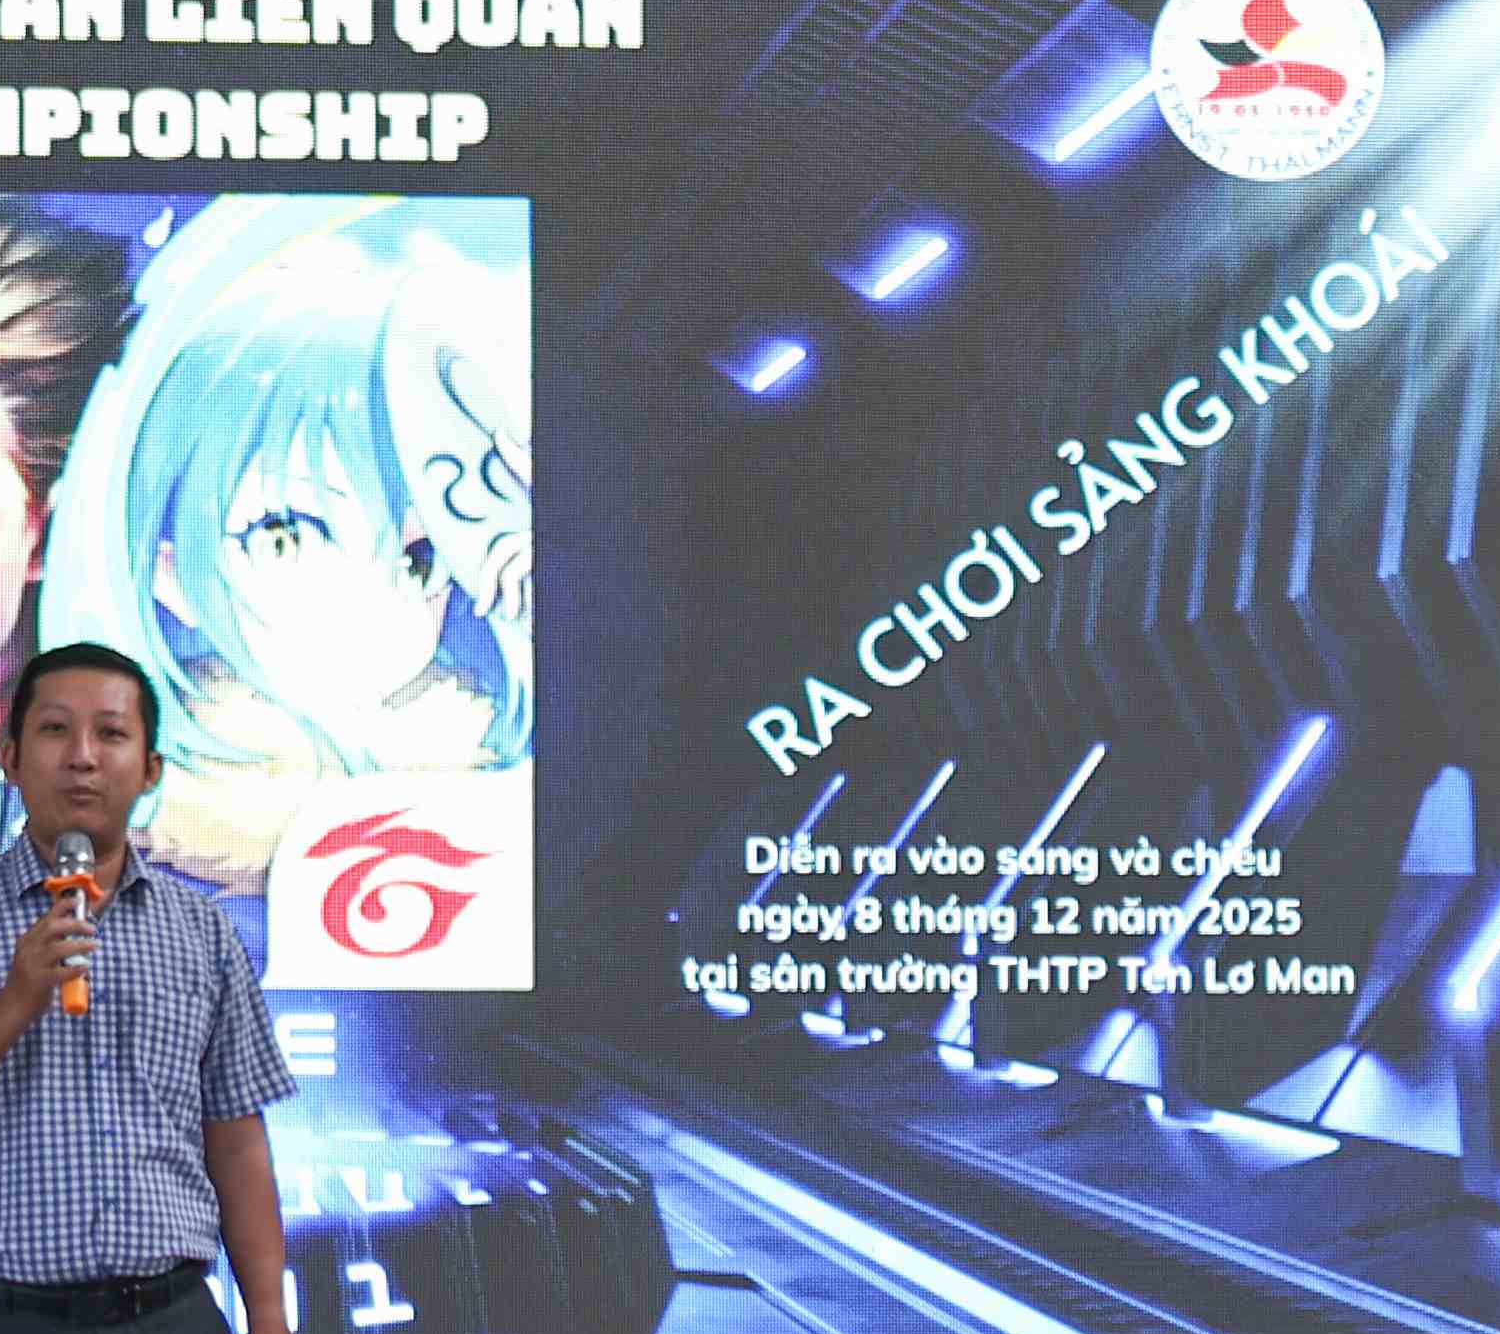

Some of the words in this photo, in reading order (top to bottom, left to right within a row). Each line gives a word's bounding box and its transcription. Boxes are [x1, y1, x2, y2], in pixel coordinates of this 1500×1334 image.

[745, 675, 873, 776] RA
[856, 524, 1043, 688] CHƠI
[1028, 375, 1236, 556] SẢNG
[1218, 205, 1453, 406] KHOÁI
[851, 845, 898, 875] ra
[907, 835, 986, 876] vào
[1108, 835, 1161, 877] và
[736, 893, 847, 942] ngày
[853, 895, 884, 934] 8
[890, 893, 1017, 944] tháng
[1029, 896, 1082, 935] 12
[1091, 895, 1190, 936] năm
[1196, 897, 1304, 937] 2025
[748, 951, 828, 993] sân
[836, 951, 979, 1001] trường
[988, 954, 1109, 995] THTP
[1117, 955, 1194, 995] Ten
[1203, 955, 1257, 995] Lơ
[1263, 957, 1357, 995] Man
[346, 1261, 415, 1328] 1
